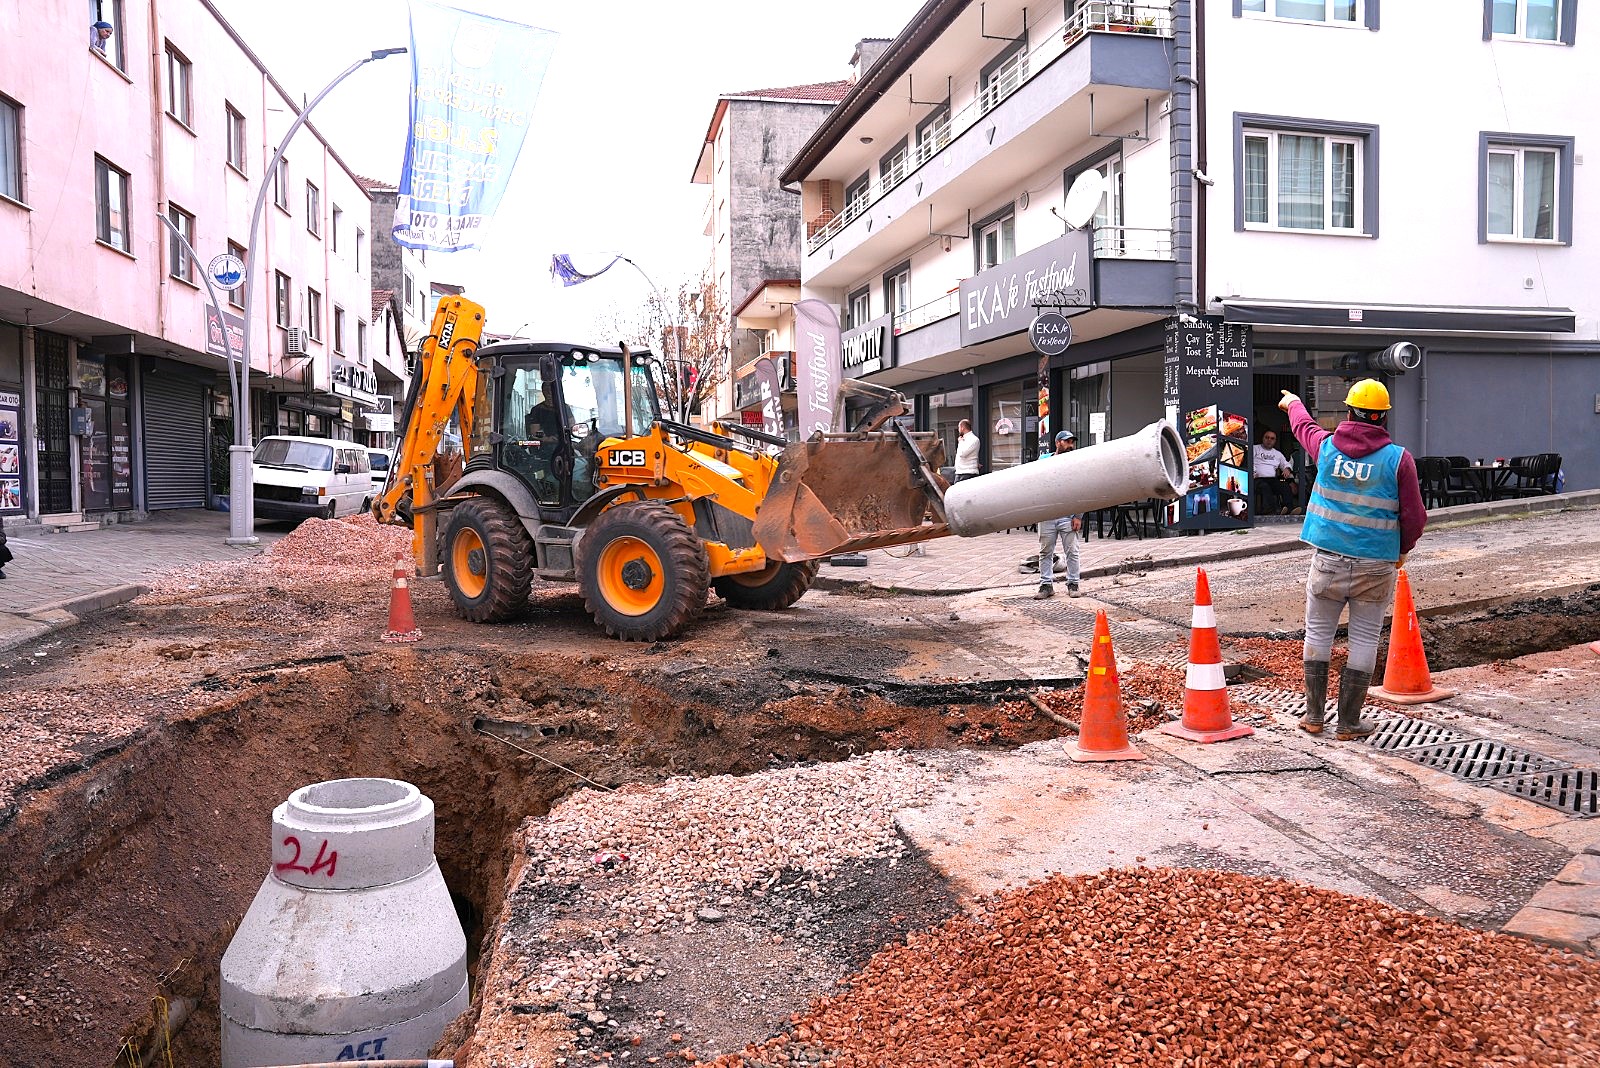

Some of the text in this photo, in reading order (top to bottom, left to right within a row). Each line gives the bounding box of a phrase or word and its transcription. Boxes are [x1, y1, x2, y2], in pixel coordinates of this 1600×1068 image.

[1023, 251, 1077, 309] Fastfood
[1038, 336, 1067, 346] Fastfood
[1186, 333, 1200, 345] Çay
[1205, 332, 1214, 358] Kahve
[1185, 346, 1201, 356] Tost
[1230, 348, 1247, 358] Tatlı
[1215, 357, 1249, 367] Limonata
[808, 331, 833, 414] Fastfood
[1185, 365, 1219, 377] Meşrubat
[1210, 375, 1240, 387] Çeşitleri
[9, 396, 19, 404] OTO
[609, 450, 646, 466] JCB
[275, 836, 338, 877] 24
